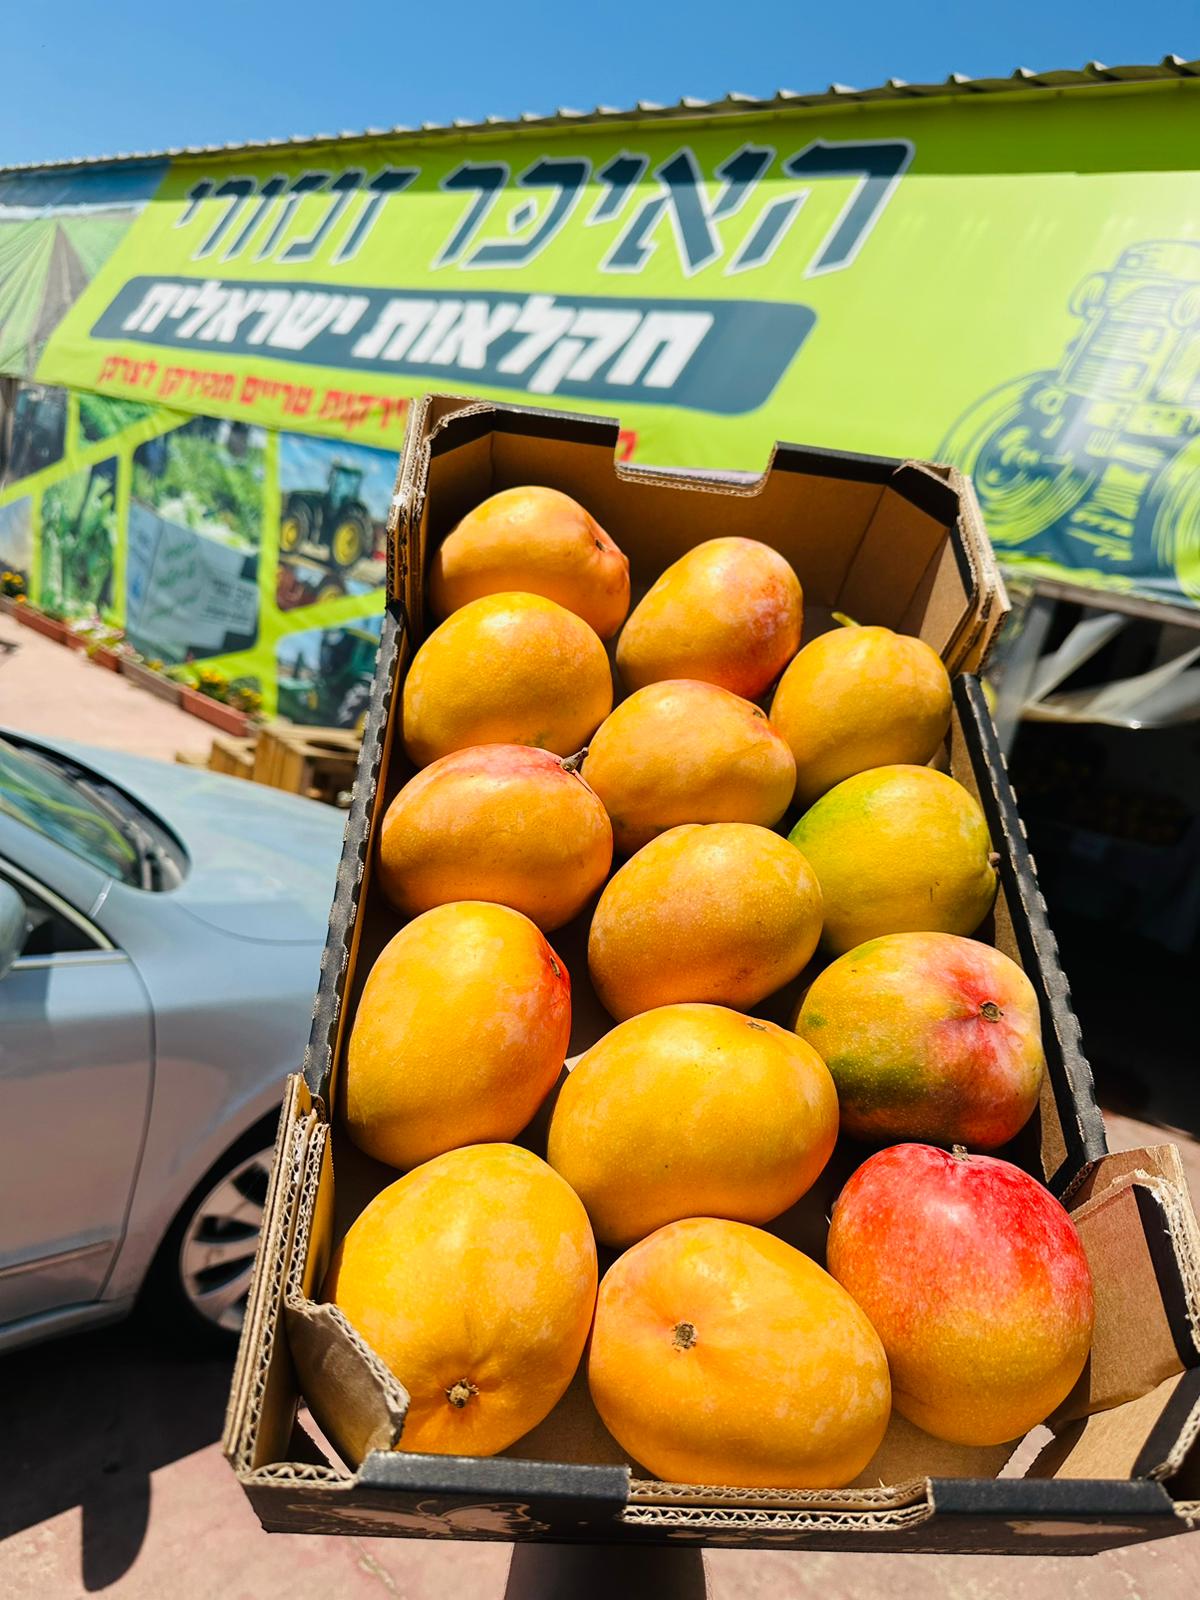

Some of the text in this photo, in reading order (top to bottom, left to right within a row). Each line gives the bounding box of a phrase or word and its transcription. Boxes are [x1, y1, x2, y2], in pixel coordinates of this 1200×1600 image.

[120, 280, 714, 395] חקלאות ישראלית
[239, 376, 314, 416] טריים
